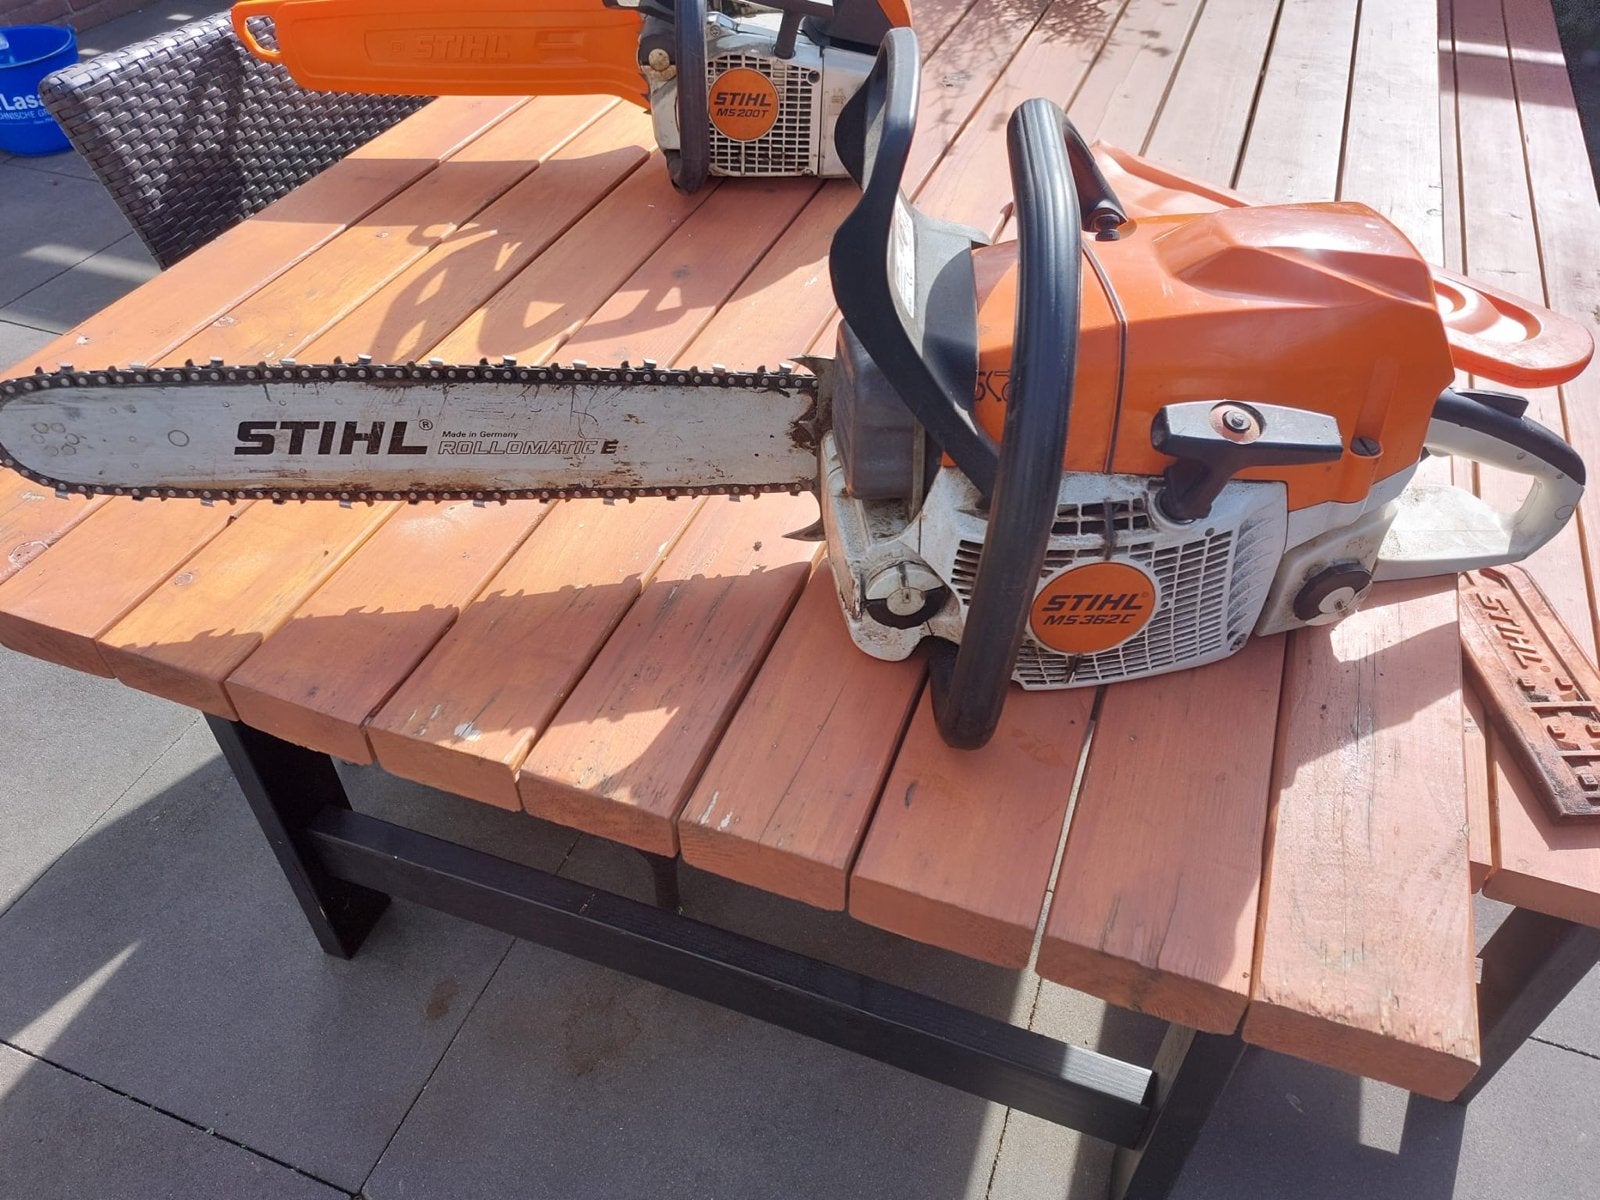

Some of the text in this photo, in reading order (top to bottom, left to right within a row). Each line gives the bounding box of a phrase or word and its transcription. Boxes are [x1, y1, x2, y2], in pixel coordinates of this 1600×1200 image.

[413, 33, 511, 60] STIHL
[0, 93, 45, 111] Las
[714, 92, 771, 107] STIHL
[234, 421, 428, 455] STIHL
[442, 430, 518, 440] Made in Germany
[438, 439, 619, 455] ROLLOMATIC E
[1042, 593, 1143, 611] STIHL
[1475, 592, 1543, 669] STIHL
